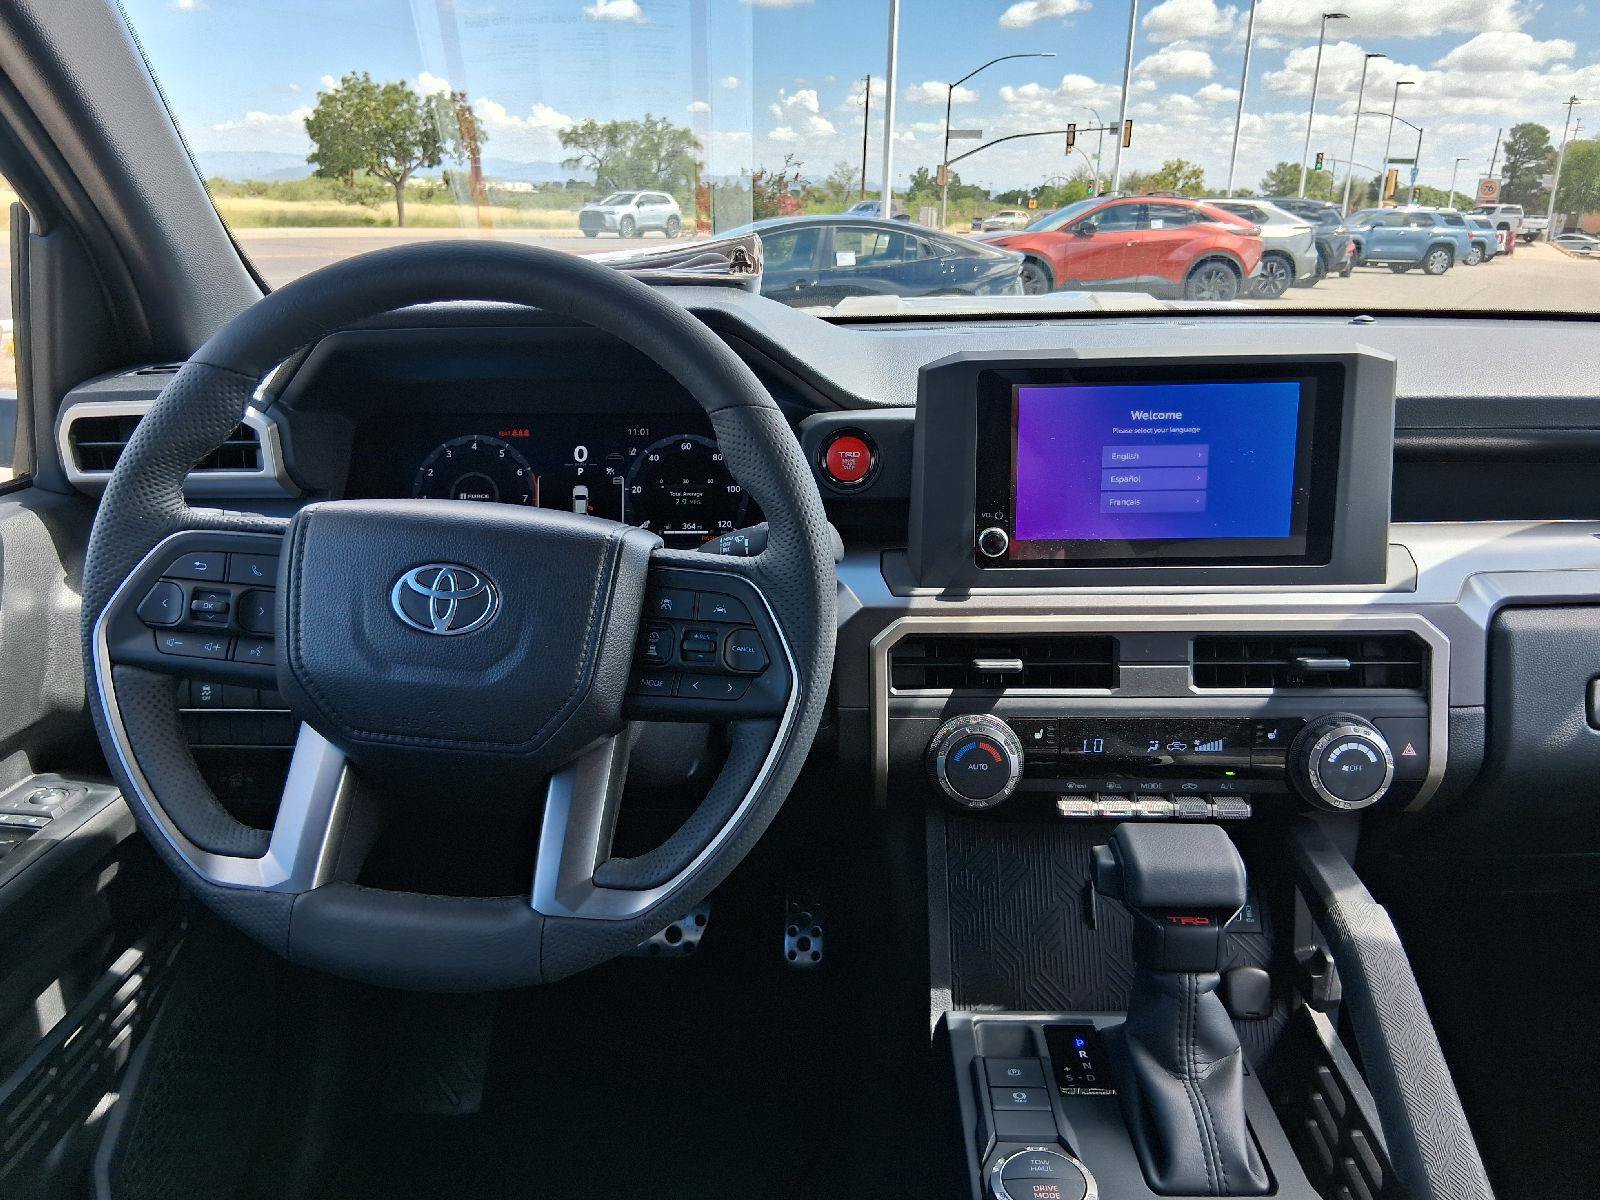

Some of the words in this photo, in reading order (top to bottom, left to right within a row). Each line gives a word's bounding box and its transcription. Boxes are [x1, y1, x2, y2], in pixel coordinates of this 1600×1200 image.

[1131, 410, 1183, 420] Welcome
[627, 427, 650, 436] 11:01
[1154, 427, 1169, 435] your
[1169, 426, 1201, 435] language
[471, 442, 477, 451] 4
[445, 450, 452, 458] 3
[499, 449, 505, 458] 5
[573, 445, 588, 463] 0
[712, 453, 723, 461] 80
[1111, 452, 1140, 462] English
[649, 454, 660, 462] 40
[427, 468, 434, 477] 2
[516, 468, 523, 476] 6
[577, 467, 584, 476] P
[1110, 475, 1141, 485] Español
[631, 486, 642, 494] 20
[726, 485, 741, 493] 100
[523, 495, 529, 503] 7
[1109, 498, 1142, 508] Français
[681, 522, 696, 530] 364
[717, 520, 732, 528] 120
[731, 645, 756, 653] CANCEL
[967, 762, 988, 771] AUTO
[1349, 764, 1363, 772] OFF
[1140, 782, 1163, 790] MODE
[1220, 782, 1235, 790] A/C
[1167, 916, 1210, 926] TRD
[1075, 1038, 1085, 1047] P
[1078, 1050, 1089, 1058] R
[1081, 1062, 1092, 1070] N
[1033, 1184, 1060, 1192] DRIVE
